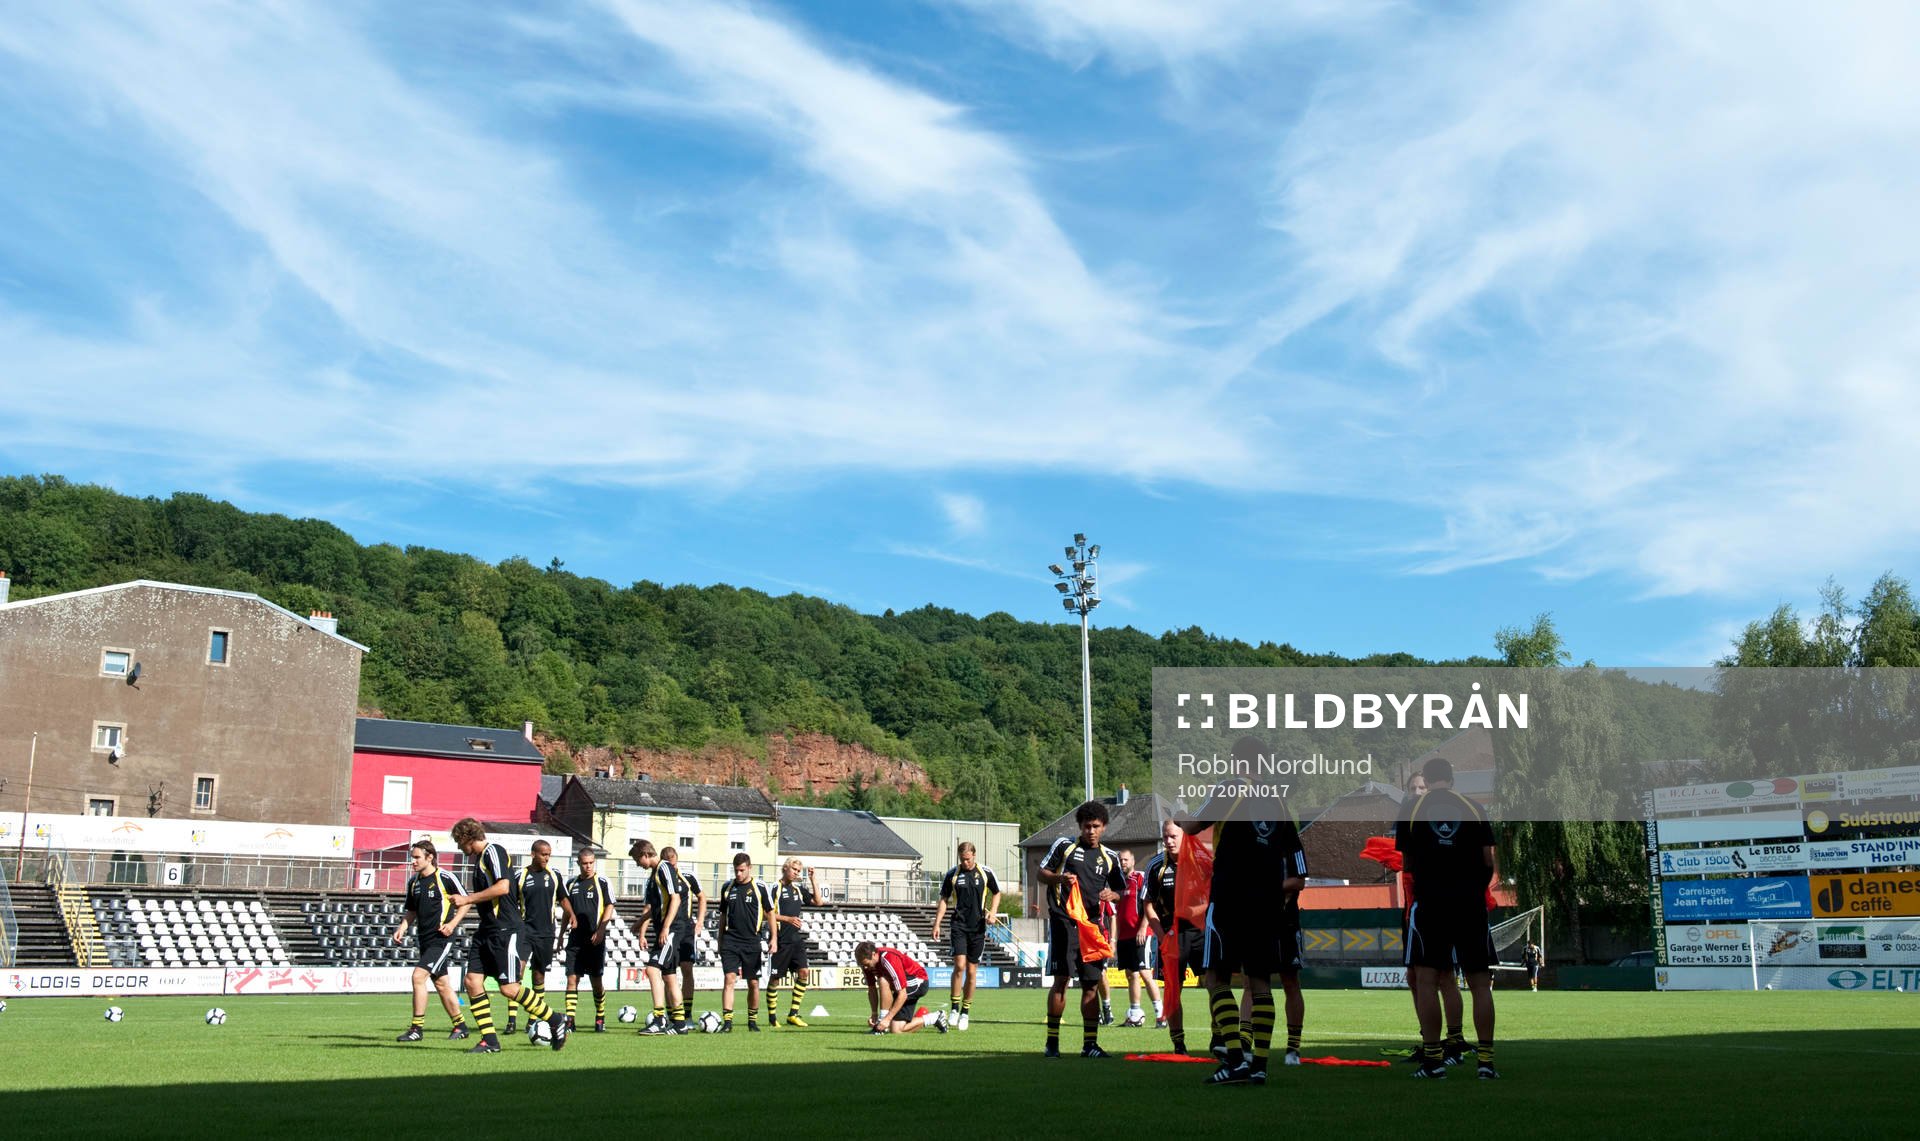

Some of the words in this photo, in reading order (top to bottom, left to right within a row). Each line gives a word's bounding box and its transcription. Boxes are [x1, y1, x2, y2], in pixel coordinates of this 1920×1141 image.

[1749, 847, 1760, 855] Le
[1763, 844, 1800, 854] BYBLOS
[1677, 857, 1700, 867] Club
[1704, 856, 1730, 865] 1900
[1871, 852, 1907, 863] Hotel
[168, 867, 178, 881] 6
[1095, 865, 1103, 875] 11
[363, 873, 371, 886] 7
[820, 887, 830, 898] 10
[1673, 898, 1698, 907] Jean
[1851, 896, 1892, 912] caffè
[1651, 882, 1667, 965] sales-lentz.lu
[1706, 929, 1741, 940] OPEL
[1670, 943, 1702, 954] Garage
[1704, 943, 1738, 952] Werner
[30, 976, 81, 989] LOGIS
[92, 975, 149, 988] DECOR
